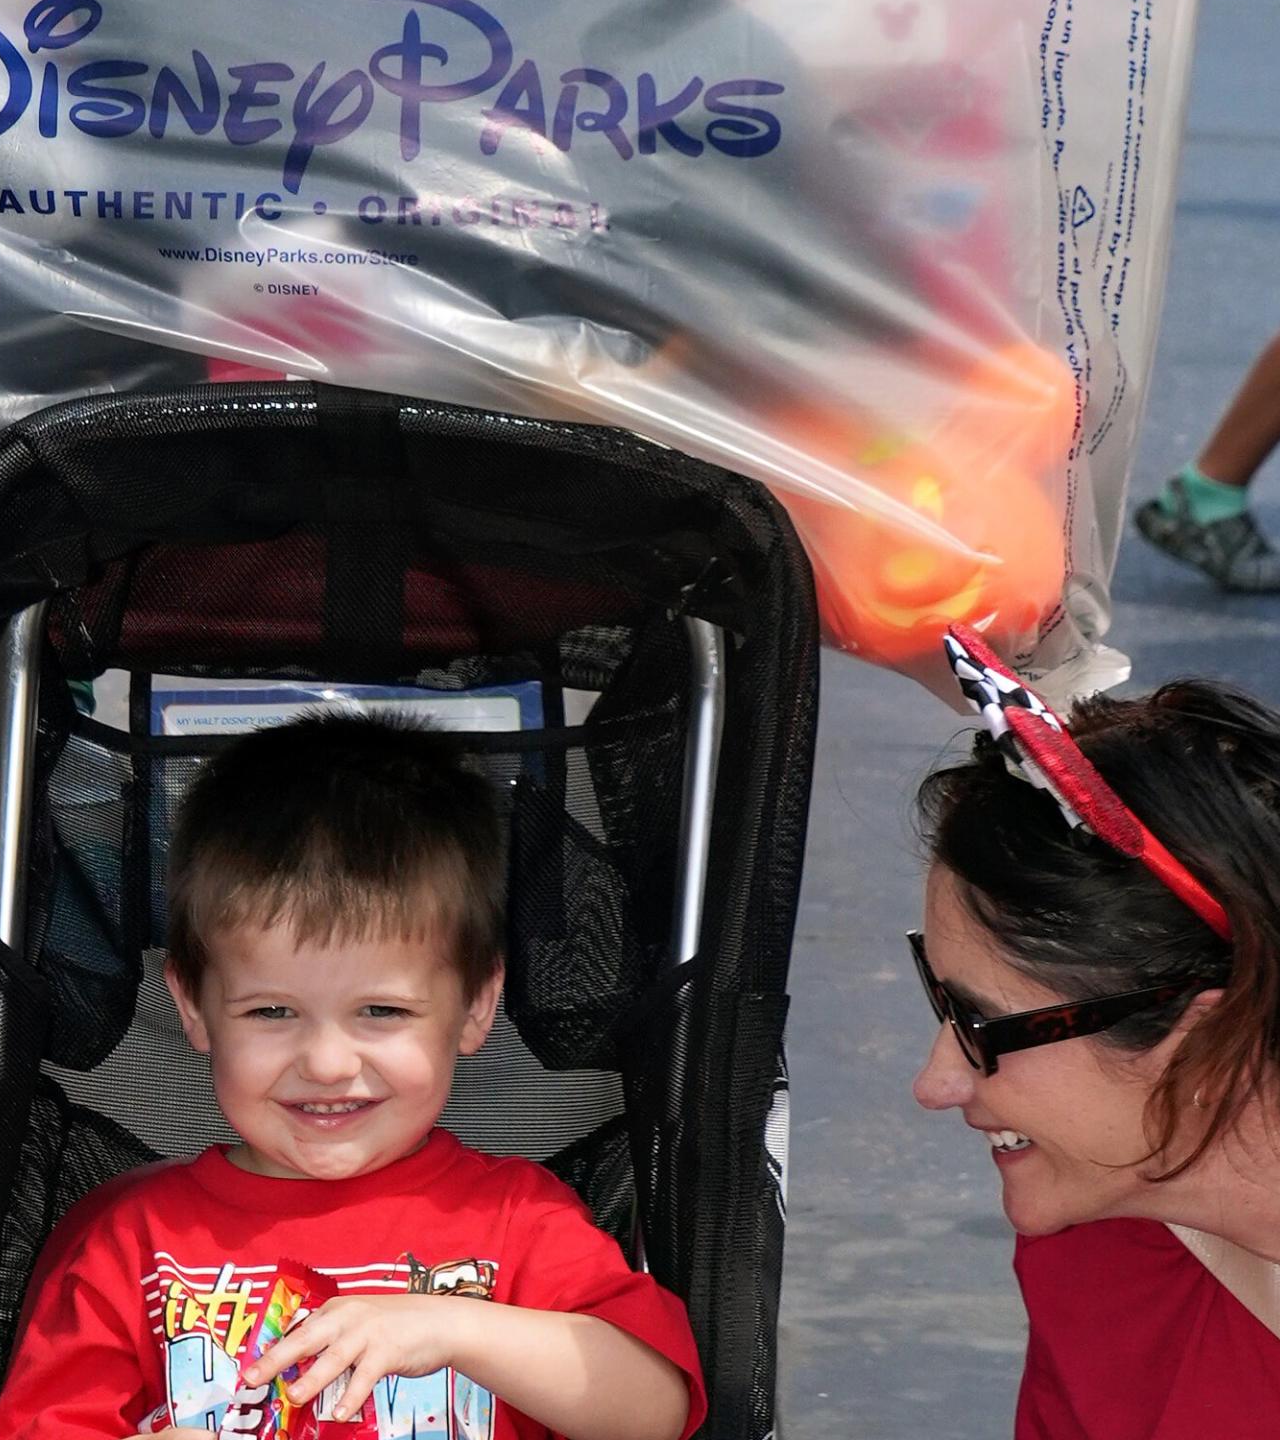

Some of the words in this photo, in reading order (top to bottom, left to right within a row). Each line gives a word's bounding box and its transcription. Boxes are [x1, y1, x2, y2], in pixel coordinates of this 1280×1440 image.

[1060, 19, 1073, 45] un
[1127, 10, 1140, 53] help
[1128, 60, 1137, 91] the
[1139, 27, 1152, 96] danger
[1052, 50, 1070, 132] juguete.
[1114, 98, 1133, 226] environment
[158, 246, 419, 267] www.DisneyParks.com/Store
[1107, 232, 1121, 257] by
[1073, 256, 1083, 276] el
[1114, 257, 1131, 306] keep
[267, 283, 319, 296] DISNEY
[1055, 242, 1074, 336] ambiente
